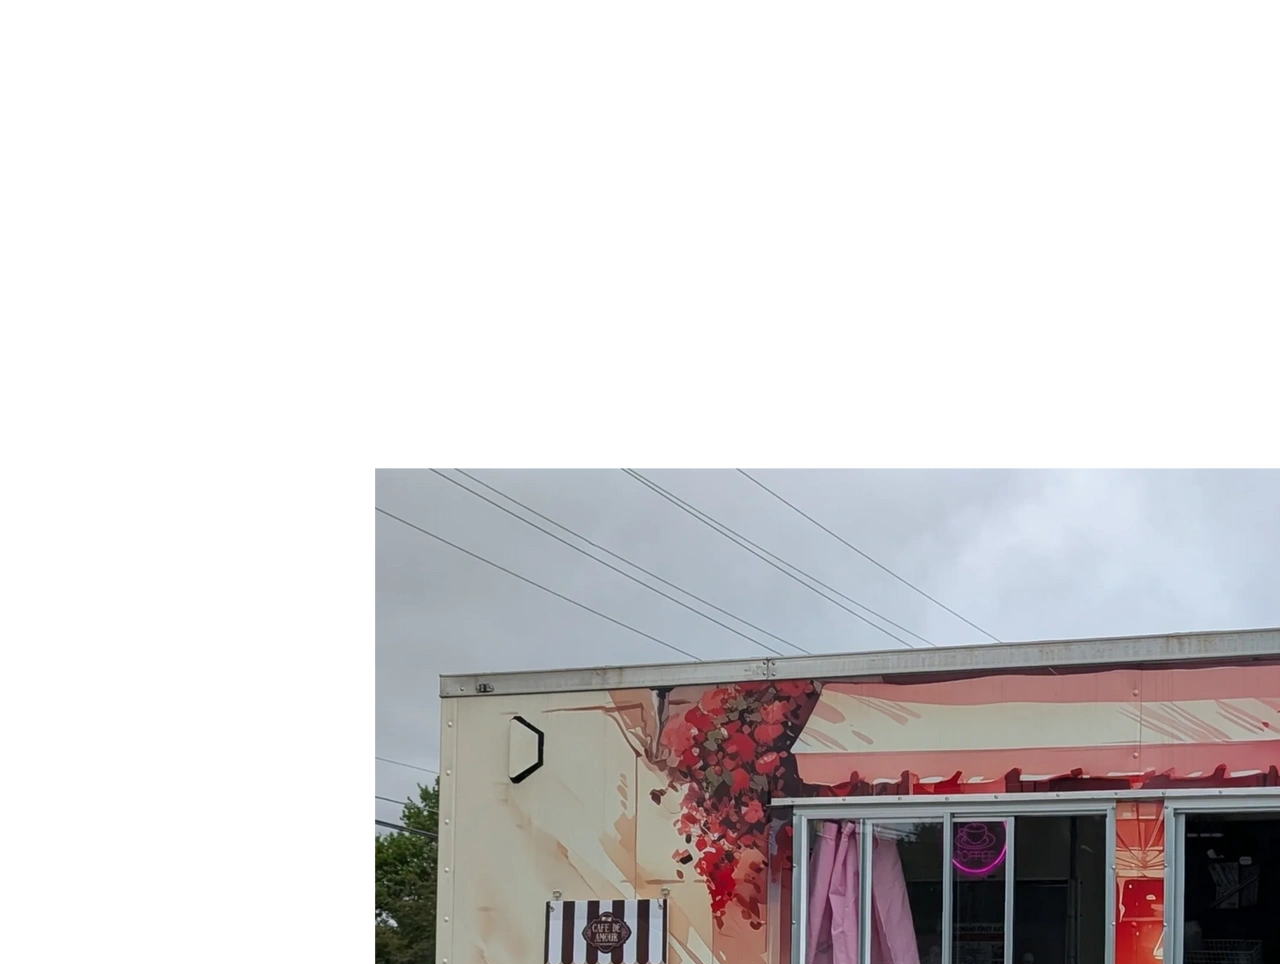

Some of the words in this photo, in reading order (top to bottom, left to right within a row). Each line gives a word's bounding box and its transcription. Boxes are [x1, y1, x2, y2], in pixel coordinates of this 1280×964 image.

[591, 923, 610, 933] CAFE
[612, 923, 621, 933] DE
[594, 932, 619, 942] AMOUR
